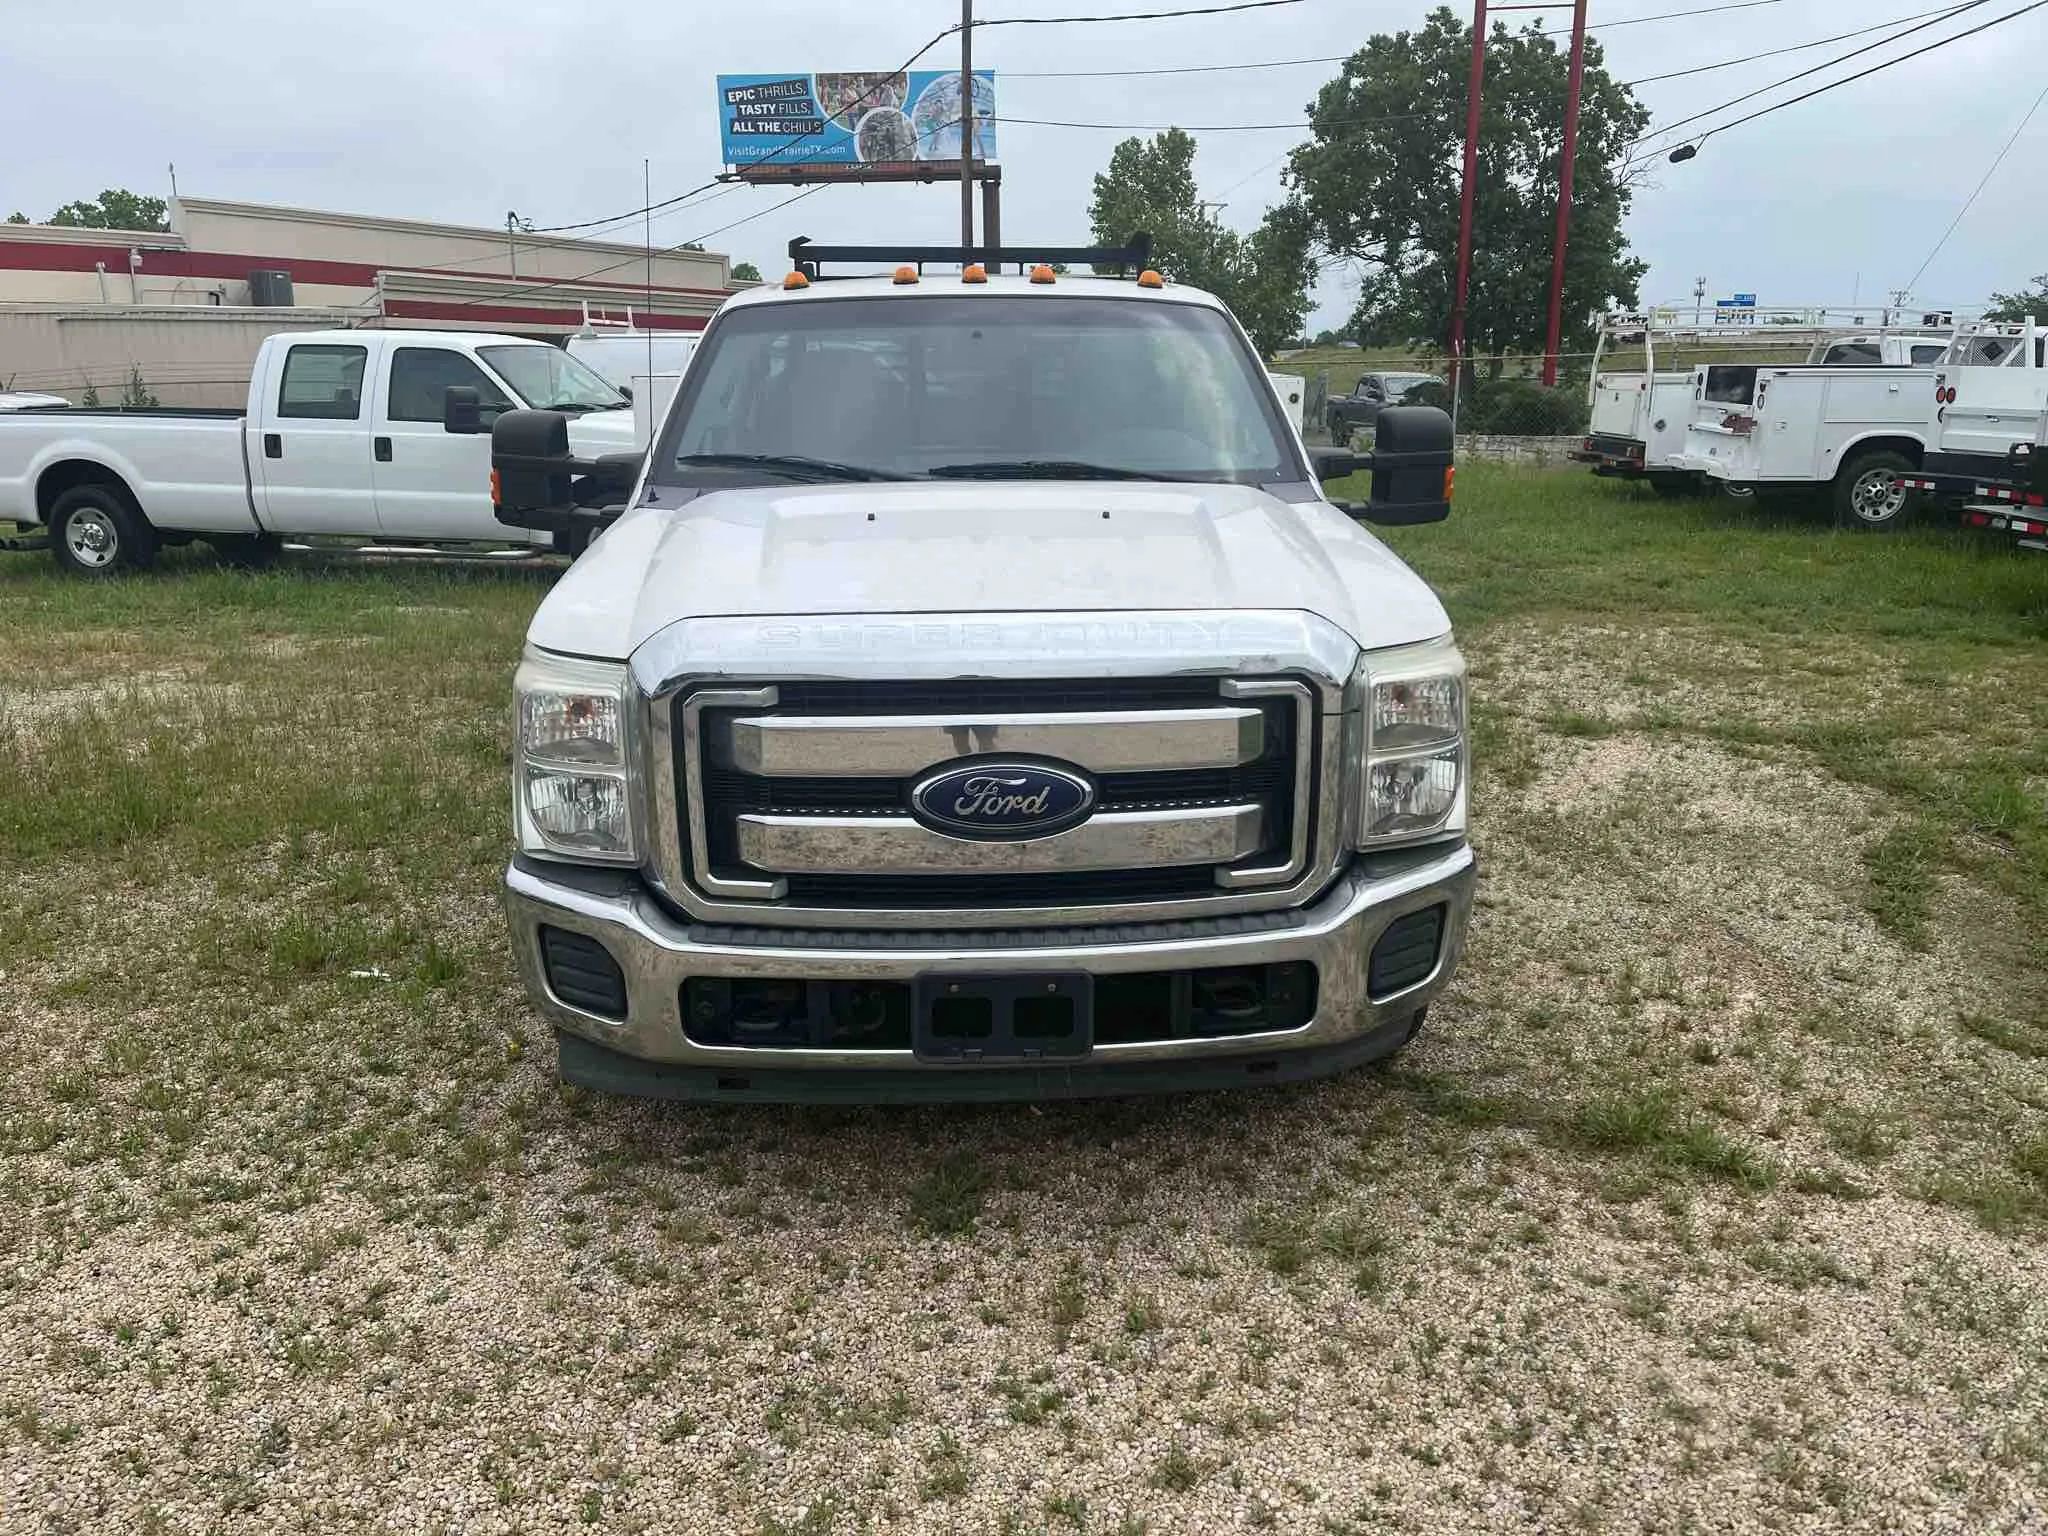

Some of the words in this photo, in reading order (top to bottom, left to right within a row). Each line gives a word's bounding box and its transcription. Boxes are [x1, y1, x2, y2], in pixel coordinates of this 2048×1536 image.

[728, 89, 755, 103] EPIC
[759, 82, 807, 97] THRILLS,
[739, 103, 776, 115] TASTY
[779, 102, 811, 115] FILLS,
[732, 121, 755, 132] ALL
[758, 121, 782, 132] THE
[758, 622, 1001, 650] SUPER
[1040, 620, 1231, 649] DUTY
[953, 777, 1051, 816] Ford
